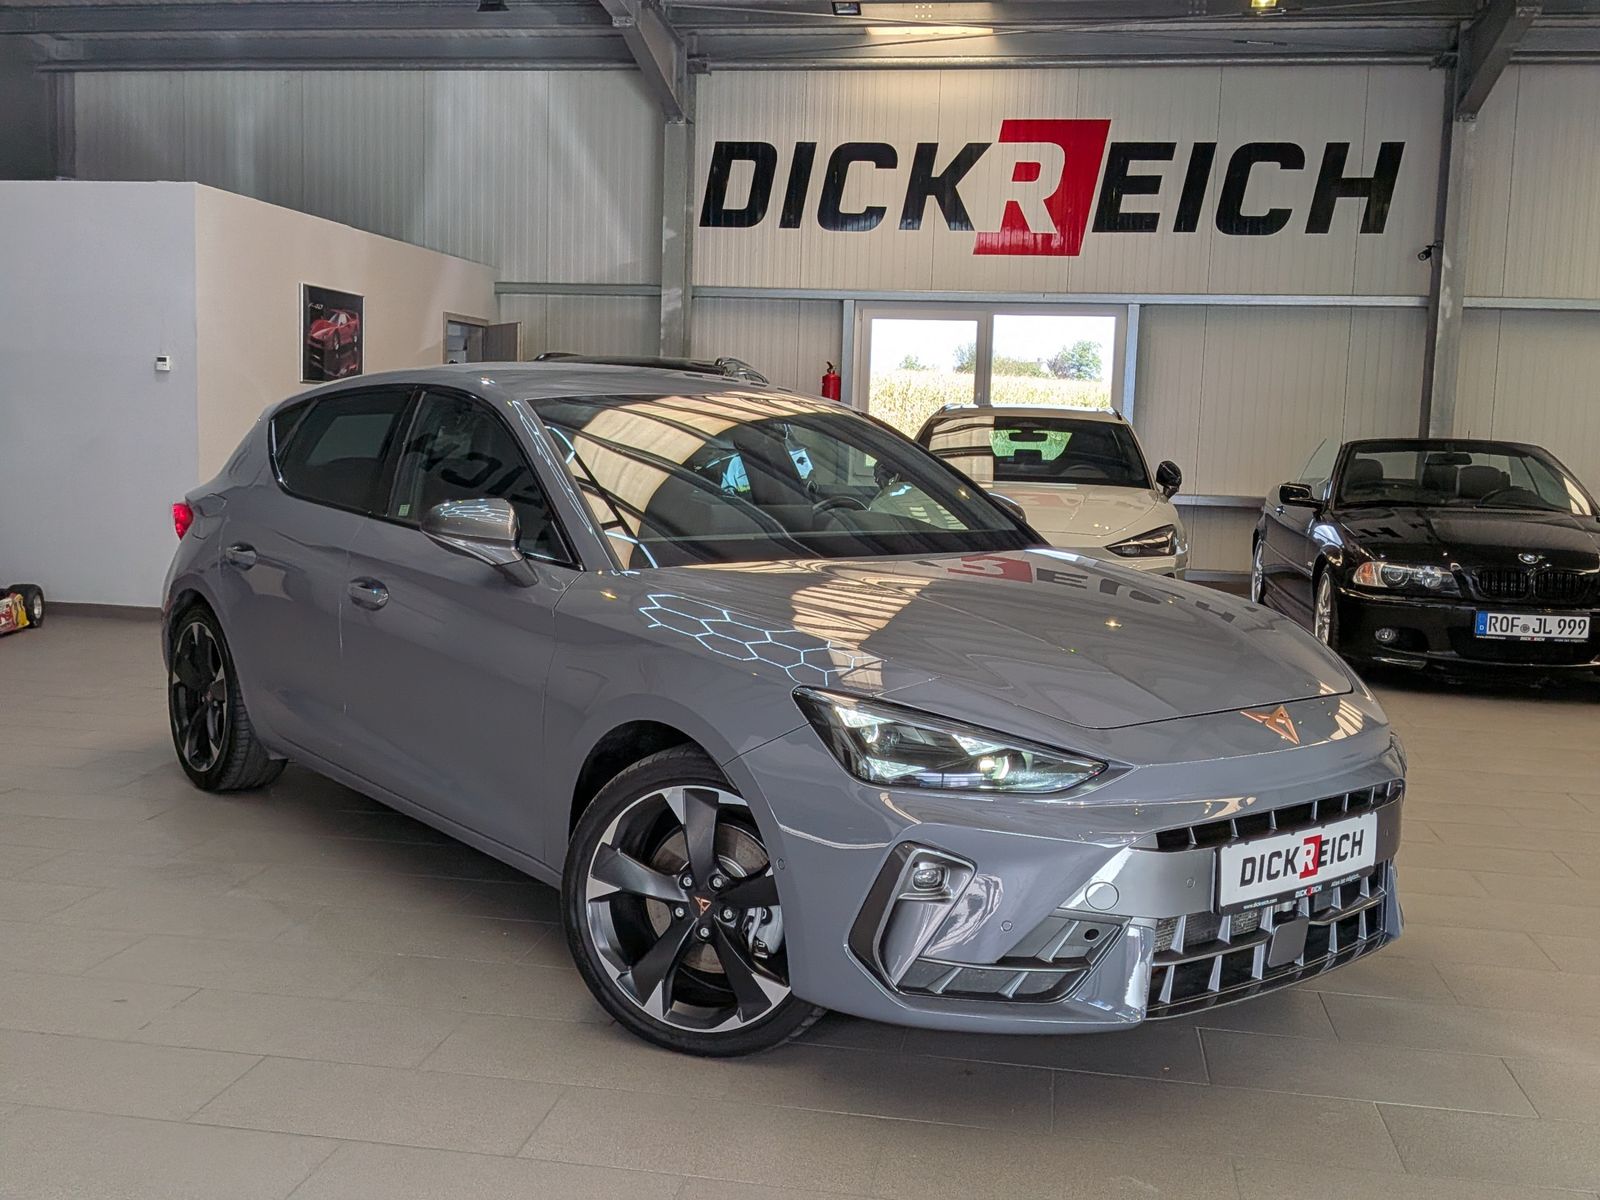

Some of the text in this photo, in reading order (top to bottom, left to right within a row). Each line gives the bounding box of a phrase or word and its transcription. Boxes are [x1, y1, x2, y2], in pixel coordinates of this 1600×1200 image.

[699, 141, 1406, 237] DICKREICH
[1488, 616, 1587, 635] ROF JL 999
[1240, 829, 1364, 887] DICKREICH
